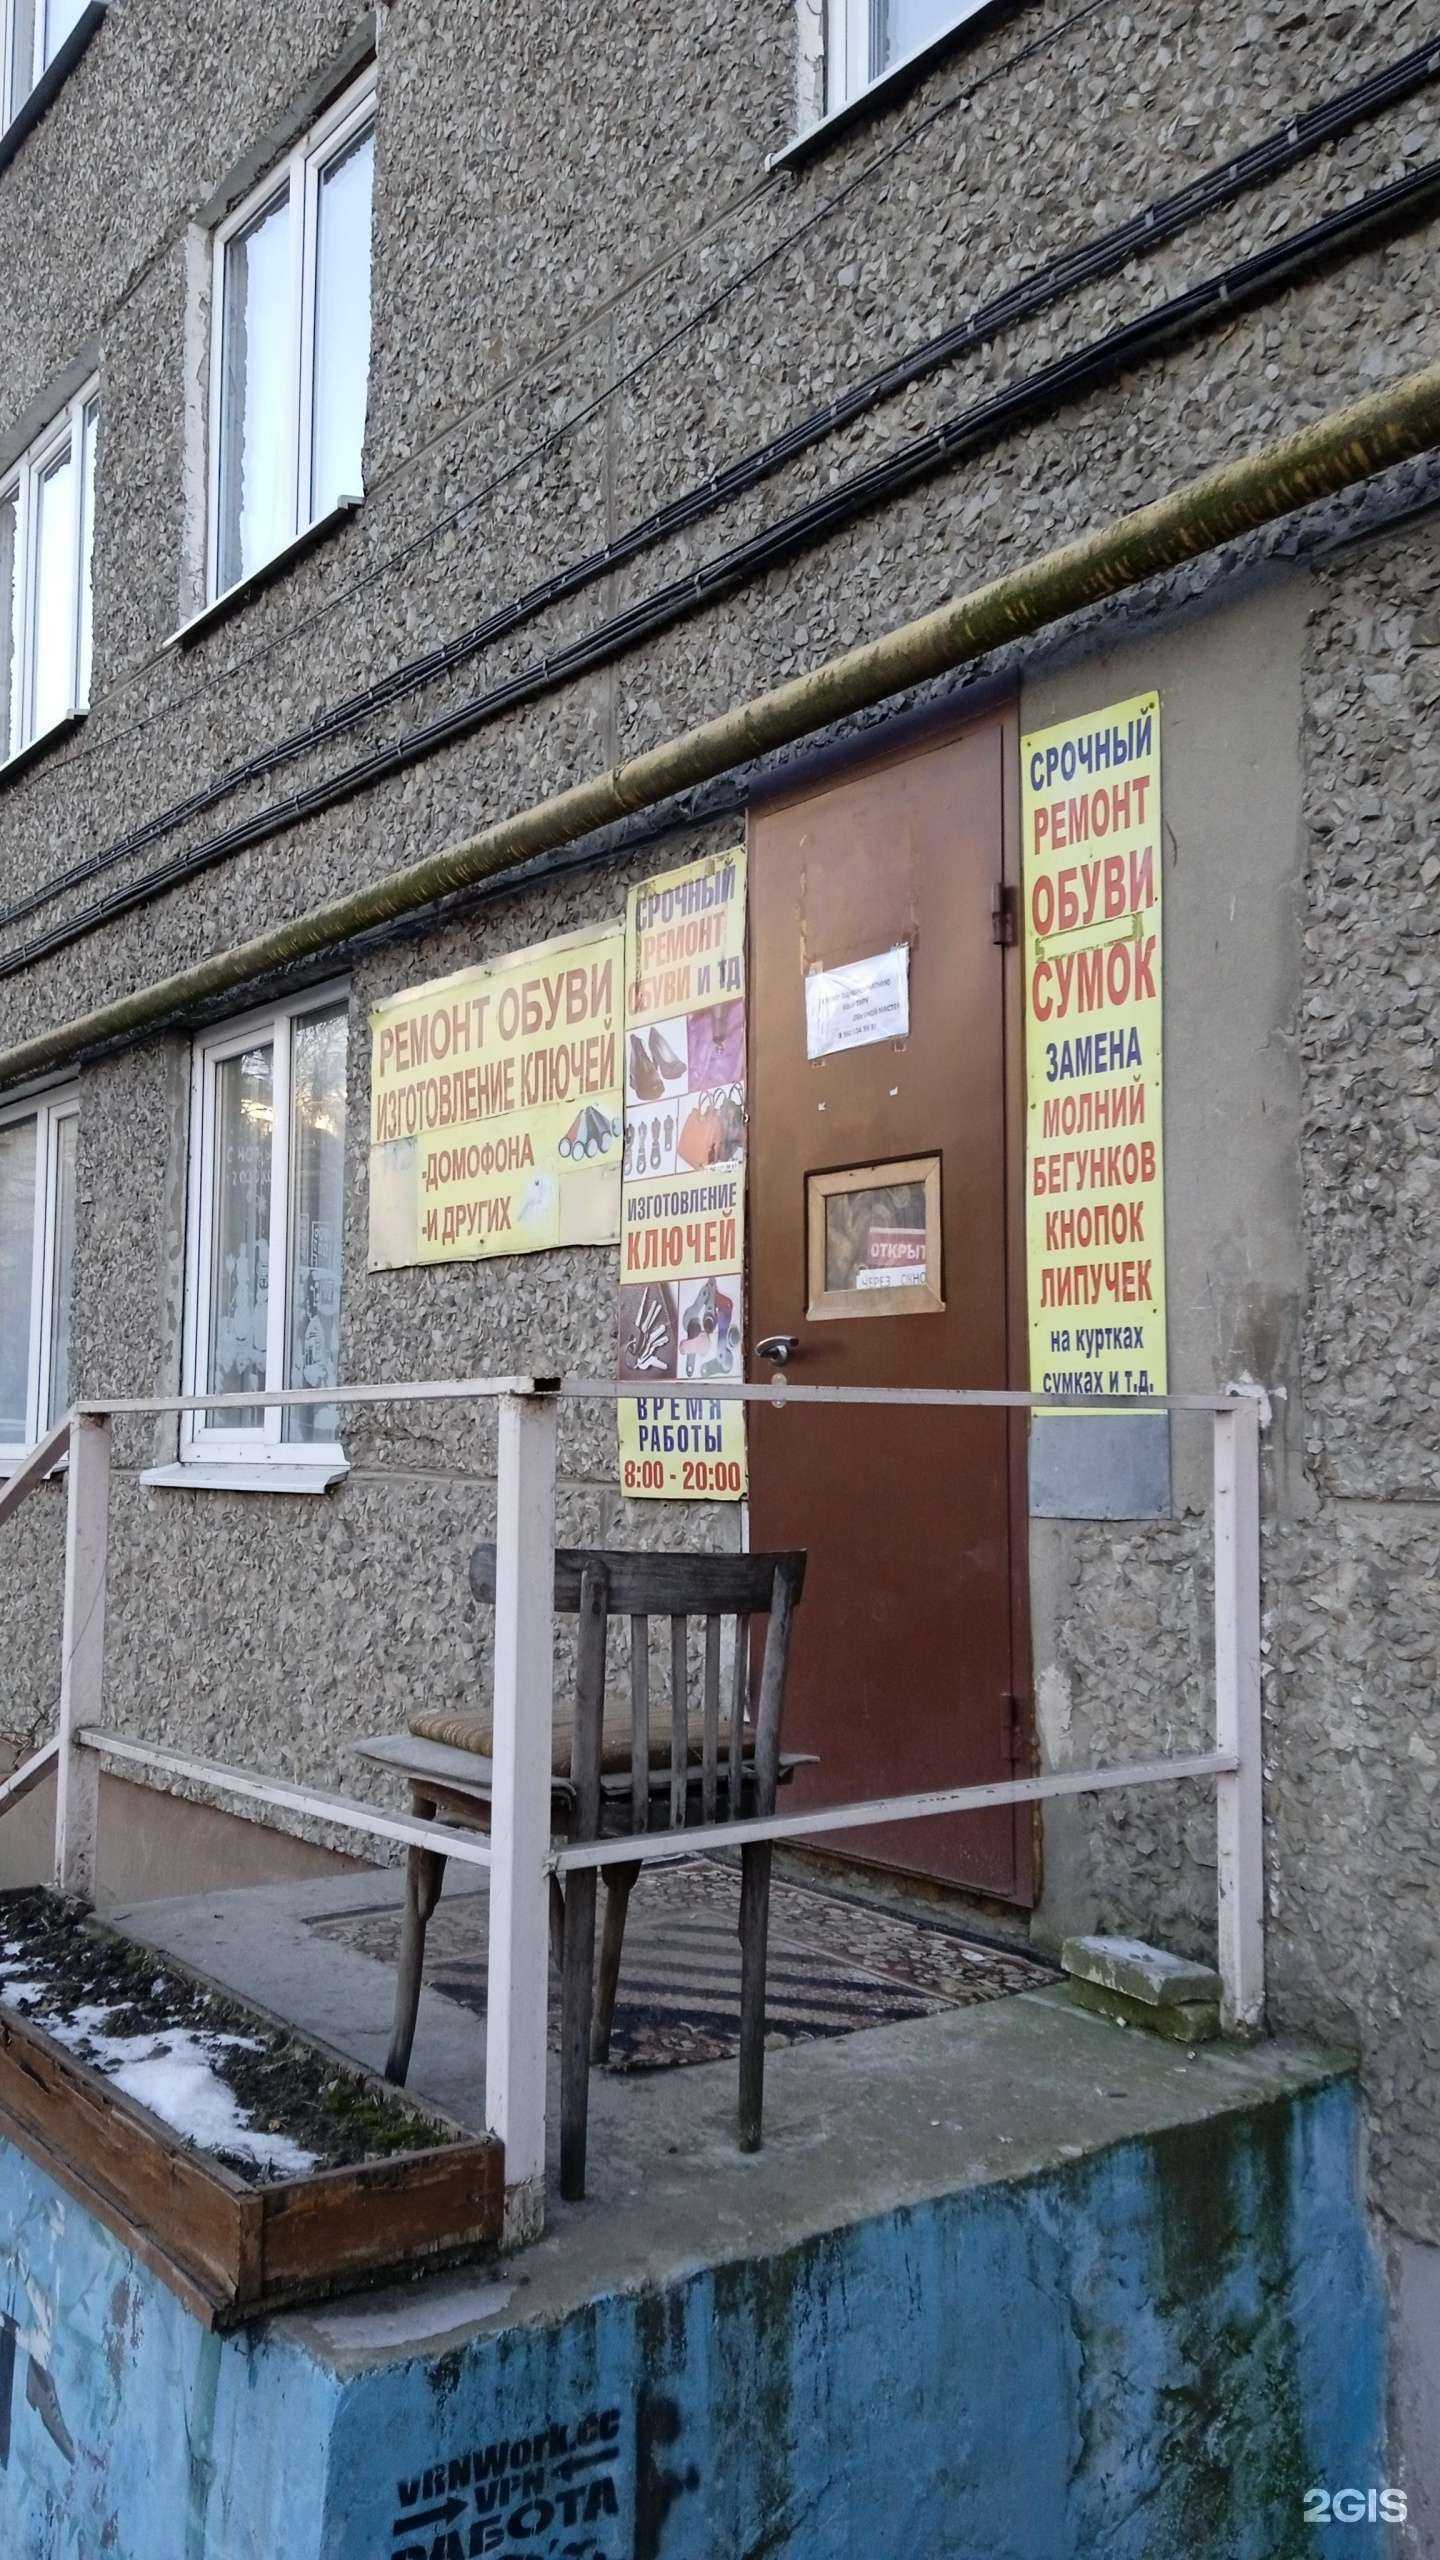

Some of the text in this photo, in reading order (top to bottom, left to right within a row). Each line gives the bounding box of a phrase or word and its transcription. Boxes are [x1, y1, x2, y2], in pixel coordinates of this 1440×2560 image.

[1030, 707, 1152, 792] СРОЧНЫЙ
[1034, 775, 1150, 855] РЕМОНТ
[636, 857, 736, 931] СРОЧНЫЙ
[1032, 846, 1154, 936] ОБУВИ
[643, 911, 725, 970] РЕМОНТ
[628, 965, 691, 1016] ОБУВИ
[1032, 935, 1156, 1022] СУМОК
[379, 958, 613, 1078] РЕМОНТ ОБУВИ
[376, 1018, 615, 1141] ИЗГОТОВЛЕНИЕ КЛЮЧЕЙ
[1046, 1026, 1142, 1082] ЗАМЕНА
[1043, 1074, 1145, 1138] МОЛНИЙ
[1033, 1140, 1157, 1196] БЕГУНКОВ
[442, 1196, 512, 1246] ДРУГИХ
[627, 1182, 737, 1222] ИЗГОТОВЛЕНИЕ
[1045, 1200, 1144, 1251] КНОПОК
[627, 1209, 736, 1270] КЛЮЧЕЙ
[1040, 1259, 1152, 1308] ЛИПУЧЕК
[1051, 1326, 1144, 1359] на куртках
[637, 1397, 722, 1421] ВРЕМЯ
[1043, 1371, 1103, 1395] сумках
[1110, 1371, 1119, 1393] и
[638, 1424, 723, 1452] РАБОТЫ
[624, 1460, 663, 1489] 8:00
[682, 1461, 741, 1492] 20:00
